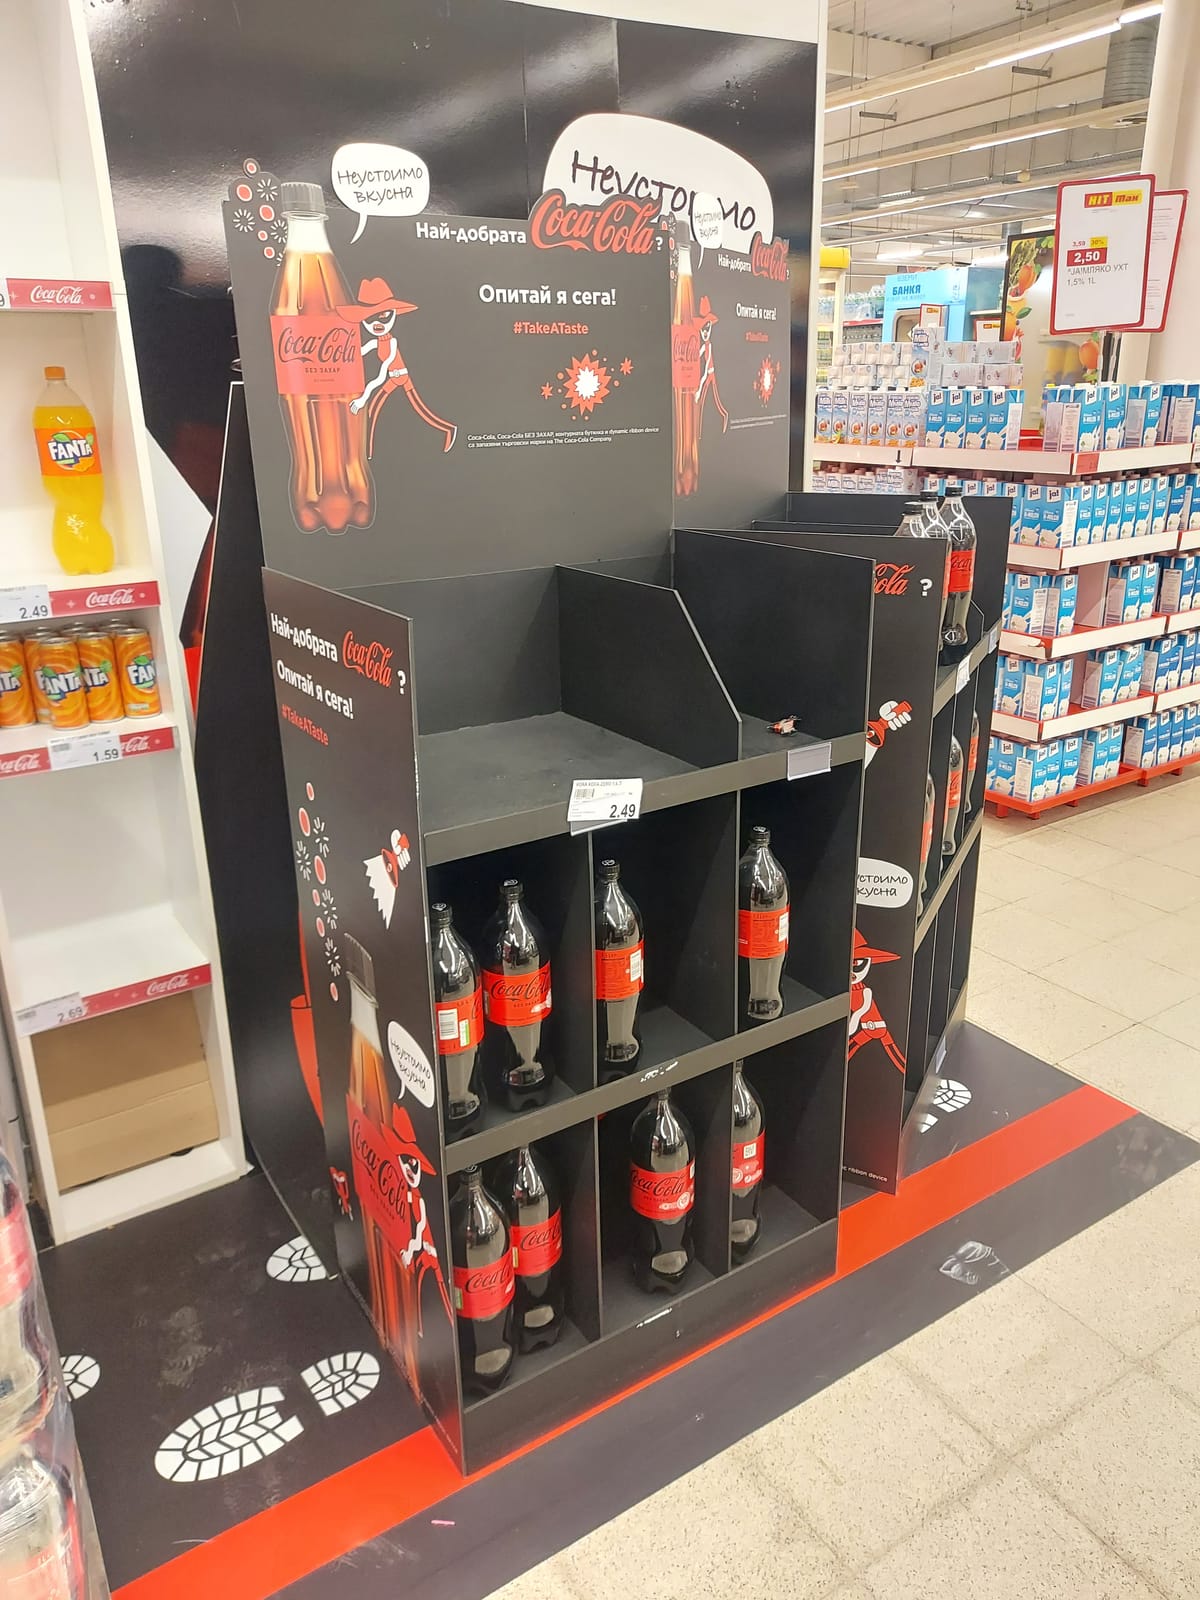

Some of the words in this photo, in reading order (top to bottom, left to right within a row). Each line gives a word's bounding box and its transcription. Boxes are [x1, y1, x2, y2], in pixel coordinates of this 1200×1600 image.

[337, 167, 423, 188] Неустоимо
[353, 186, 413, 206] вкусна
[1088, 194, 1109, 206] HIT
[416, 221, 527, 246] Най-добрата
[532, 194, 660, 254] Coca-Cola
[752, 234, 788, 282] Coca-Cola
[1074, 251, 1101, 265] 2,50
[30, 284, 84, 304] Coca-Cola
[479, 284, 551, 306] Опитай
[557, 291, 568, 304] я
[572, 289, 617, 306] сега!
[892, 284, 921, 296] БАНКА
[513, 321, 589, 335] #TakeATaste
[278, 327, 357, 363] Coca-Cola
[47, 439, 93, 461] FANTA
[1029, 487, 1039, 498] ja!
[1049, 489, 1059, 500] ja!
[919, 578, 933, 597] ?
[86, 588, 135, 608] Coca-Cola
[19, 604, 49, 620] 2.49
[270, 612, 338, 663] Най-добрата
[342, 630, 393, 688] Coca-Cola
[397, 670, 406, 694] ?
[276, 659, 315, 697] Опитай
[316, 684, 323, 701] я
[324, 689, 354, 720] сега!
[281, 703, 329, 746] #TakeATaste
[93, 748, 119, 763] 1.59
[609, 804, 636, 819] 2.49
[147, 974, 189, 996] Coca-Cola
[352, 1119, 406, 1223] Coca-Cola
[868, 1171, 888, 1182] device
